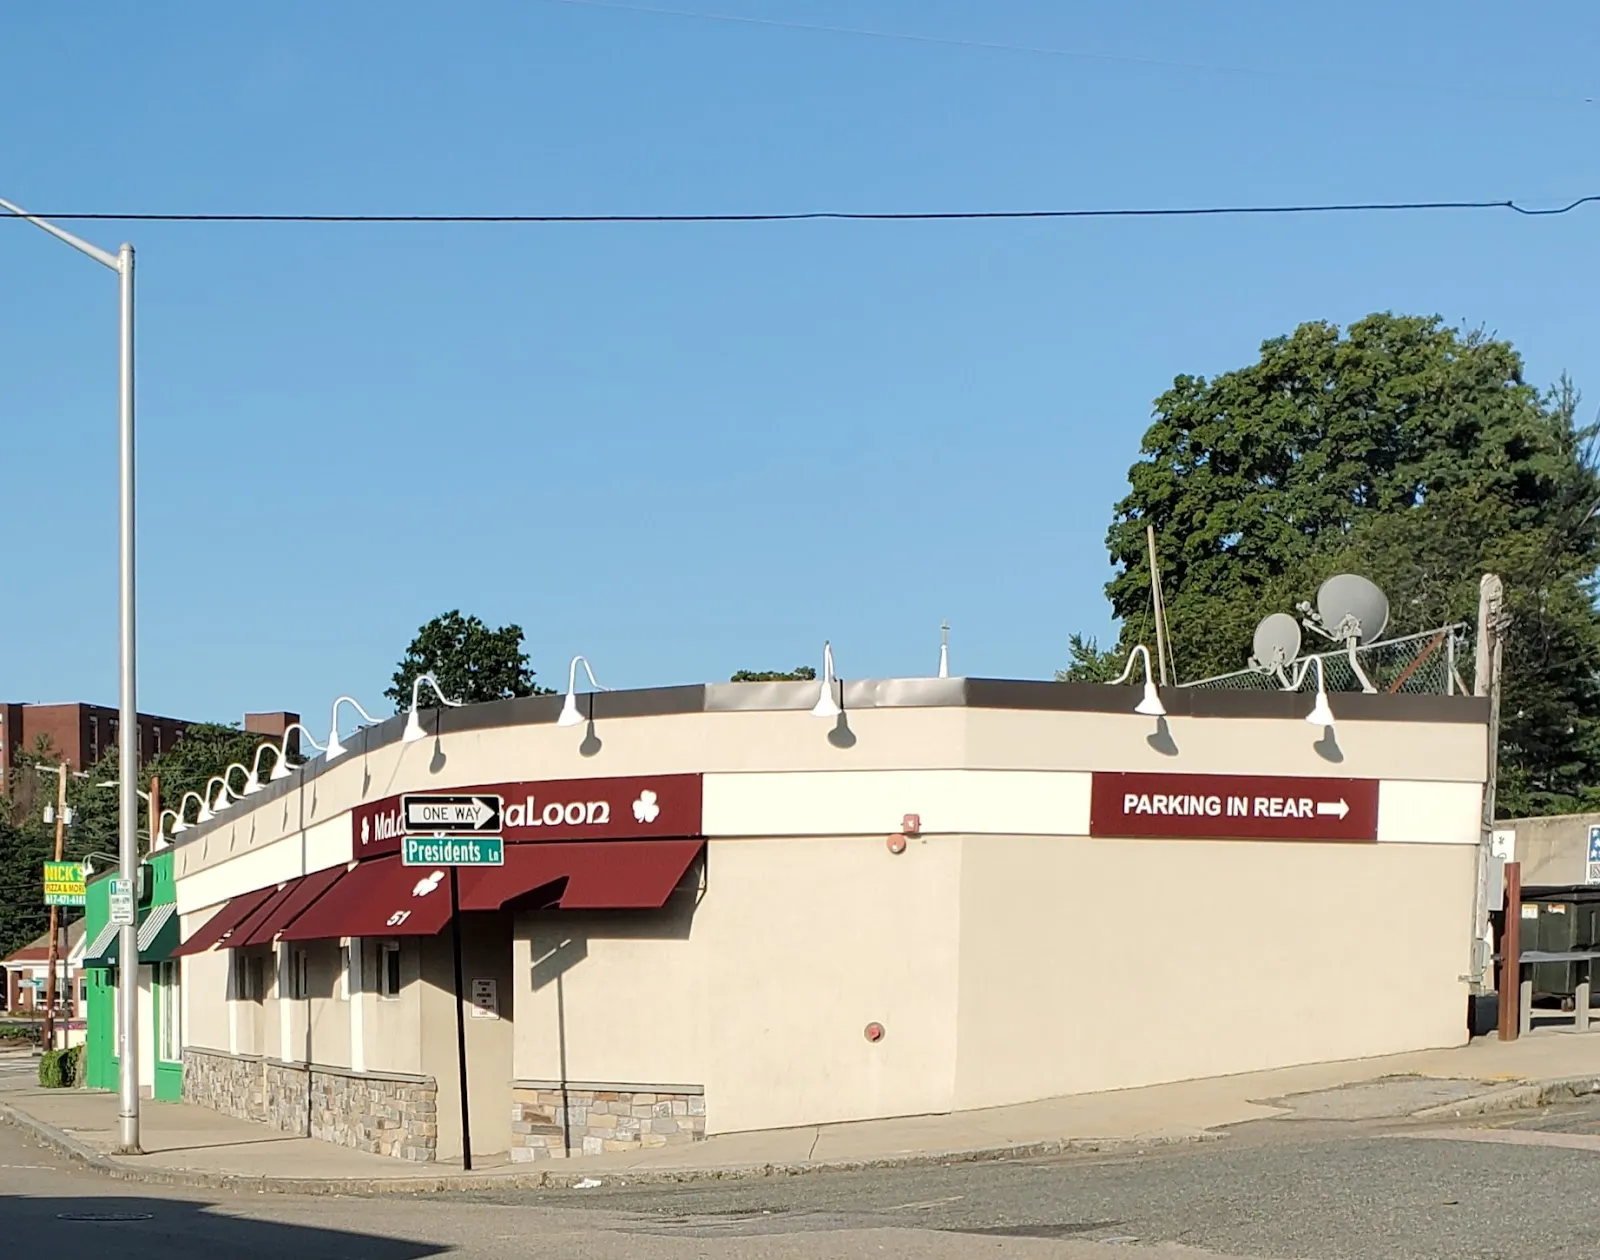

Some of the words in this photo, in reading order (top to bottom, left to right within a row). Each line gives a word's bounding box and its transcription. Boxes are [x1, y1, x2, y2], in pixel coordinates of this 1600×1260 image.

[422, 806, 449, 821] ONE
[454, 806, 481, 821] WAY
[1123, 794, 1221, 817] PARKING
[1226, 796, 1248, 817] IN
[1253, 797, 1315, 818] REAR
[408, 839, 481, 862] Presidents
[488, 848, 499, 861] Ln
[45, 865, 86, 881] NICK'S
[46, 883, 61, 893] PIZZA
[386, 910, 411, 926] 51
